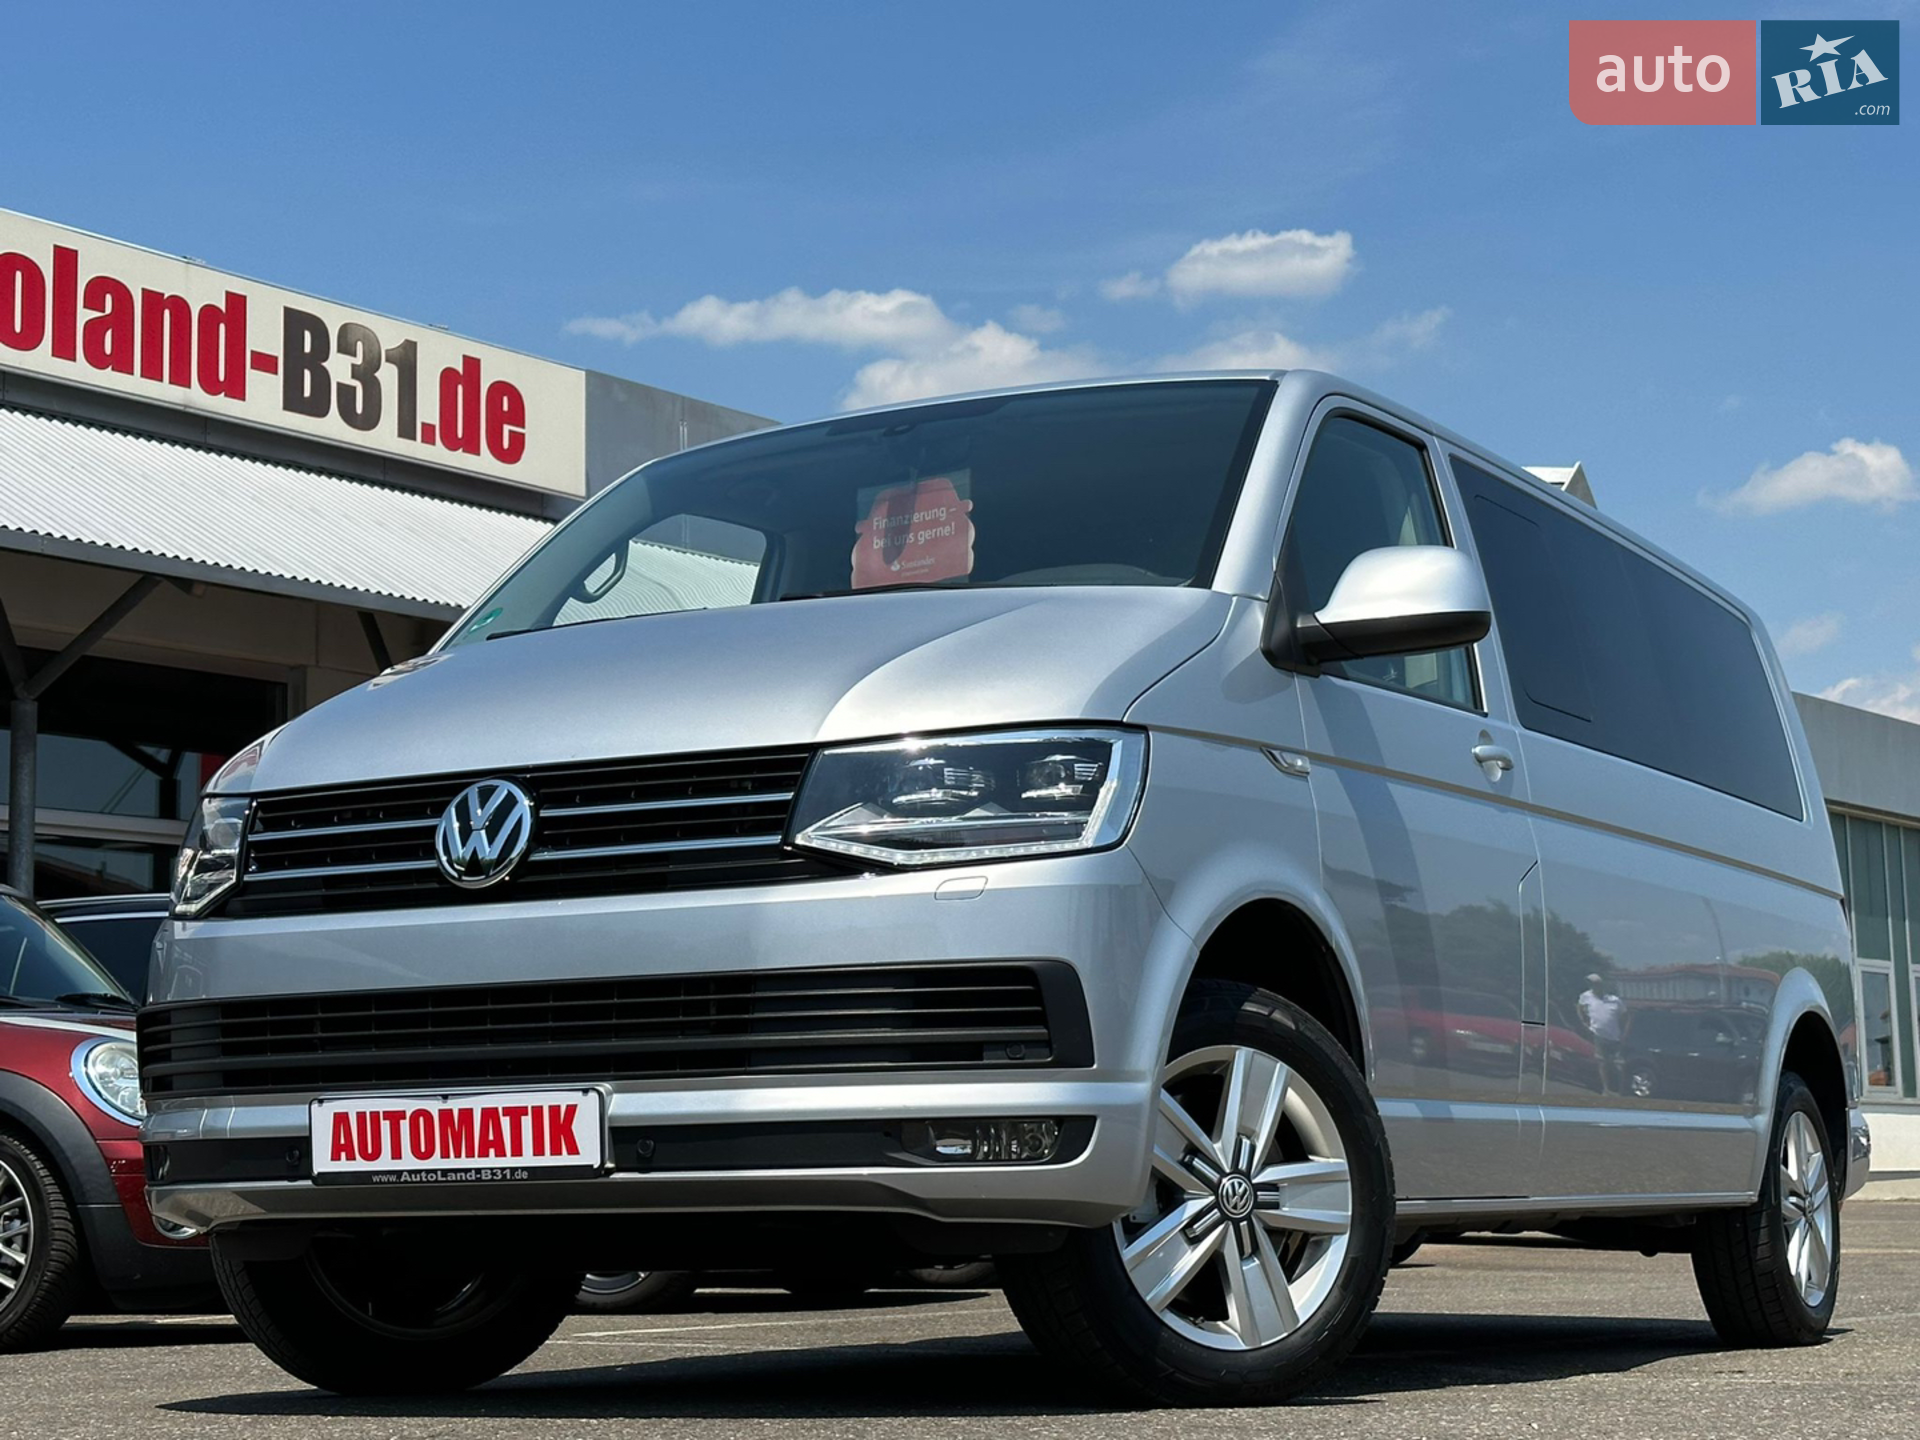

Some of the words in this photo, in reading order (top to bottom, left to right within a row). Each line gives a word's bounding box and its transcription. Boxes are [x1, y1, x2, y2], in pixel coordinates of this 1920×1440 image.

[873, 507, 946, 531] Finanzierung
[873, 535, 892, 549] bei
[894, 532, 914, 546] uns
[918, 522, 955, 545] gerne!
[330, 1103, 580, 1162] AUTOMATIK
[372, 1168, 528, 1183] www.AutoLand-B31.de
